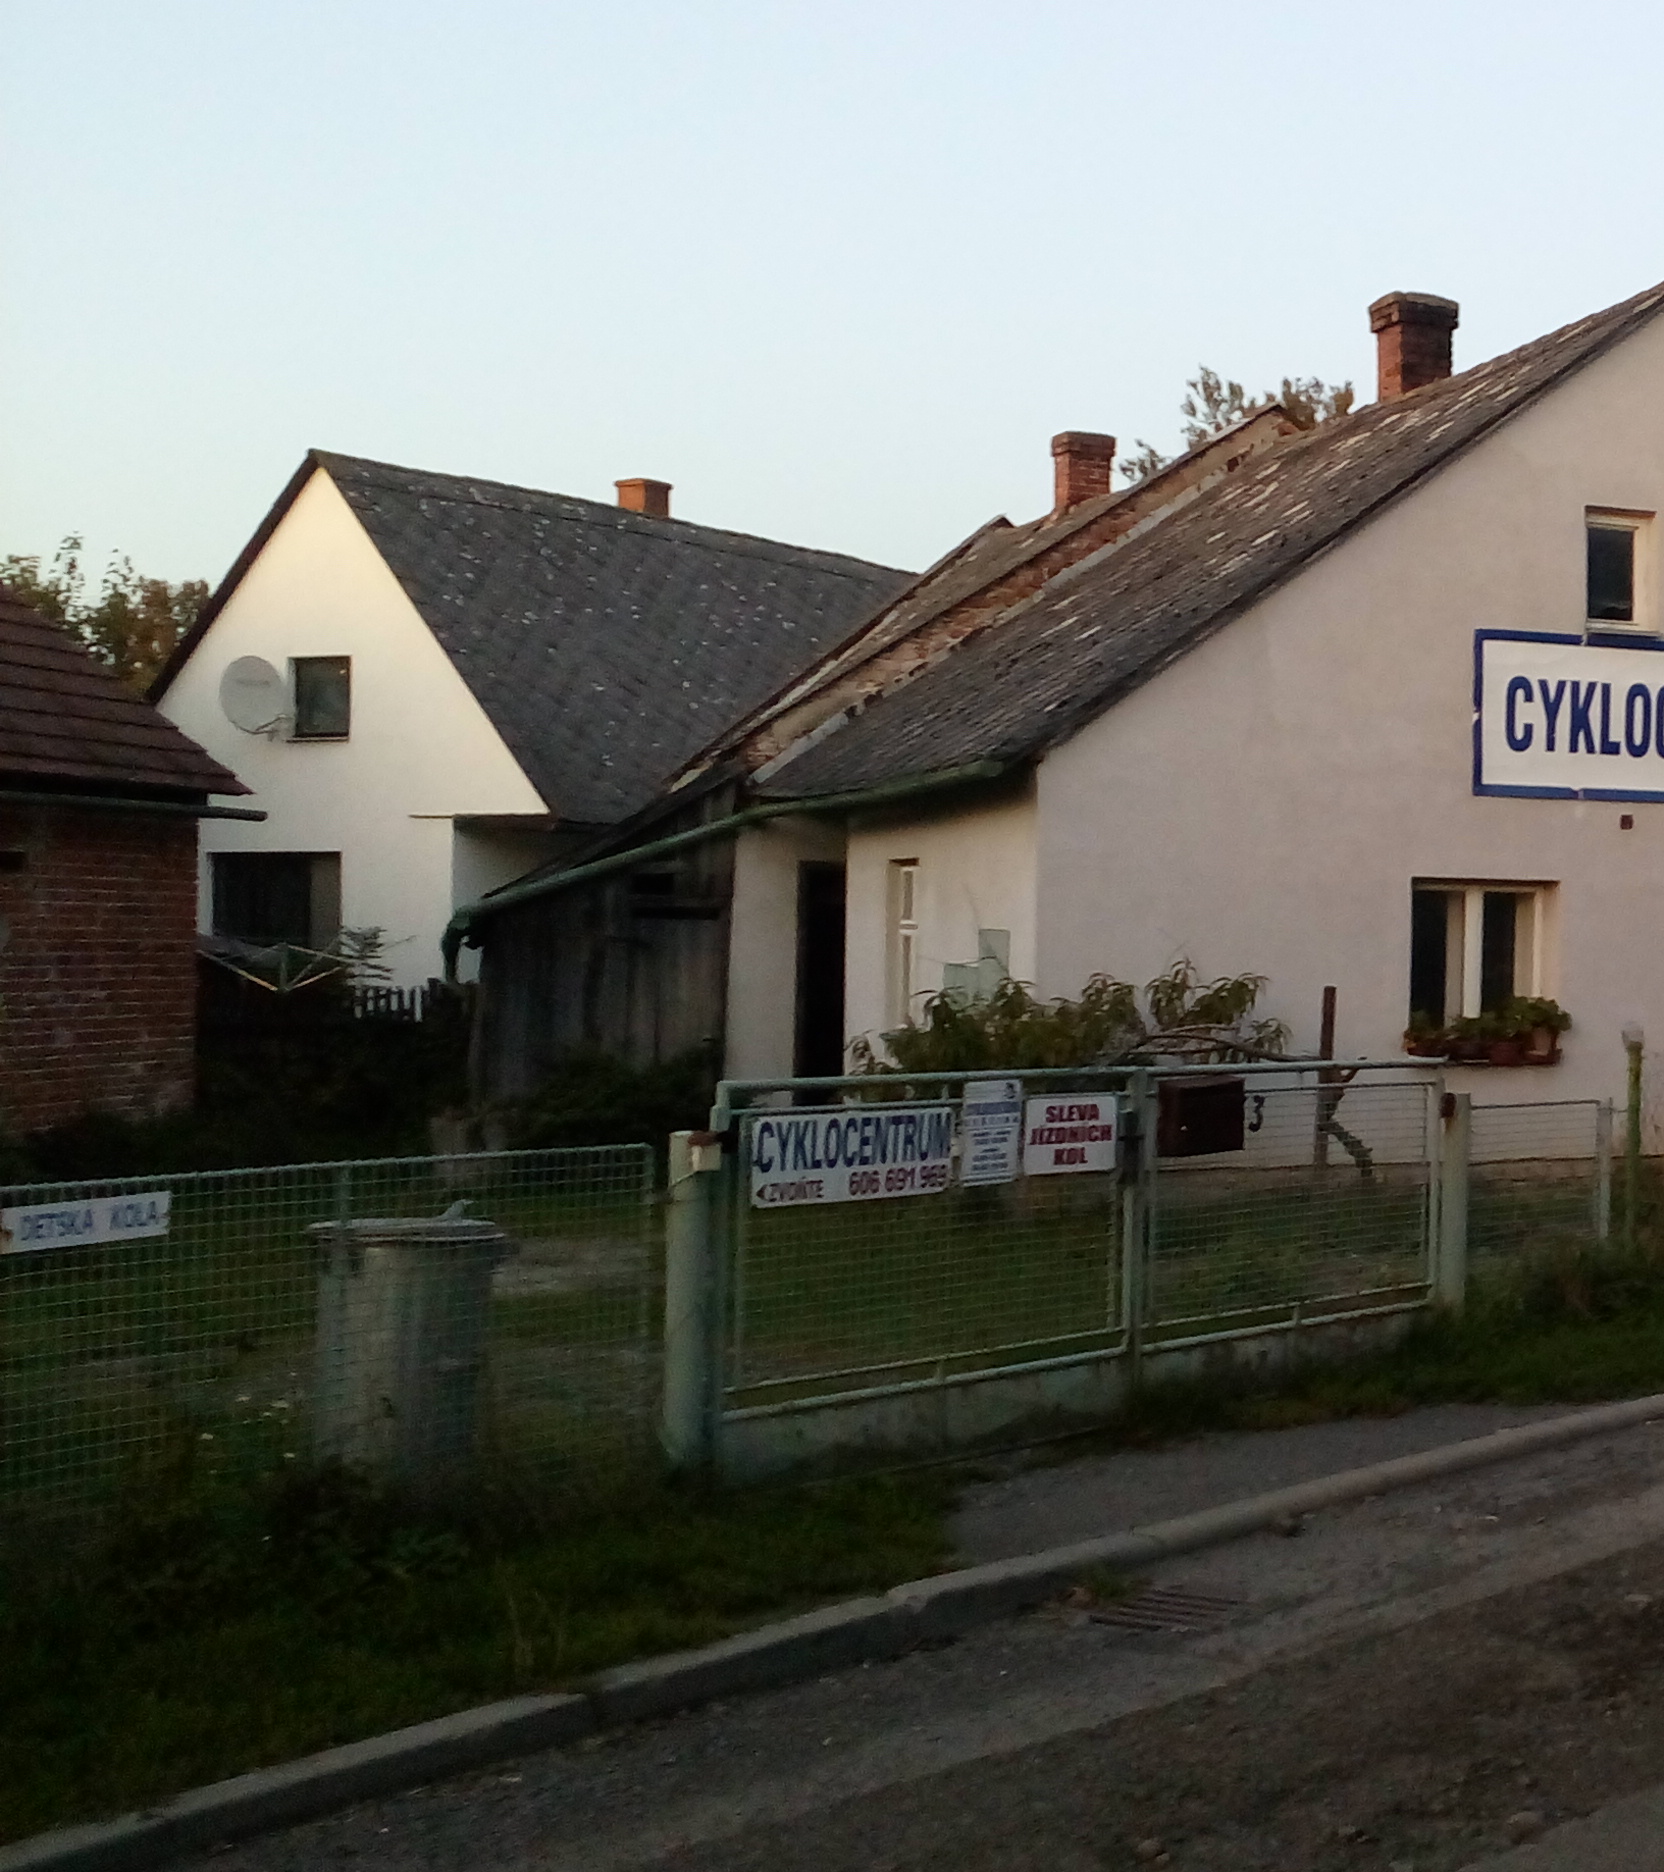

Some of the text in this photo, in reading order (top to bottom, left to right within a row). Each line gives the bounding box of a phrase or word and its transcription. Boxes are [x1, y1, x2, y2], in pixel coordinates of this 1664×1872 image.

[1045, 1104, 1099, 1123] SLEVA
[1248, 1095, 1265, 1133] 3
[757, 1112, 951, 1173] CYKLOCENTRUM
[1053, 1146, 1089, 1165] KOL
[849, 1170, 881, 1196] 606
